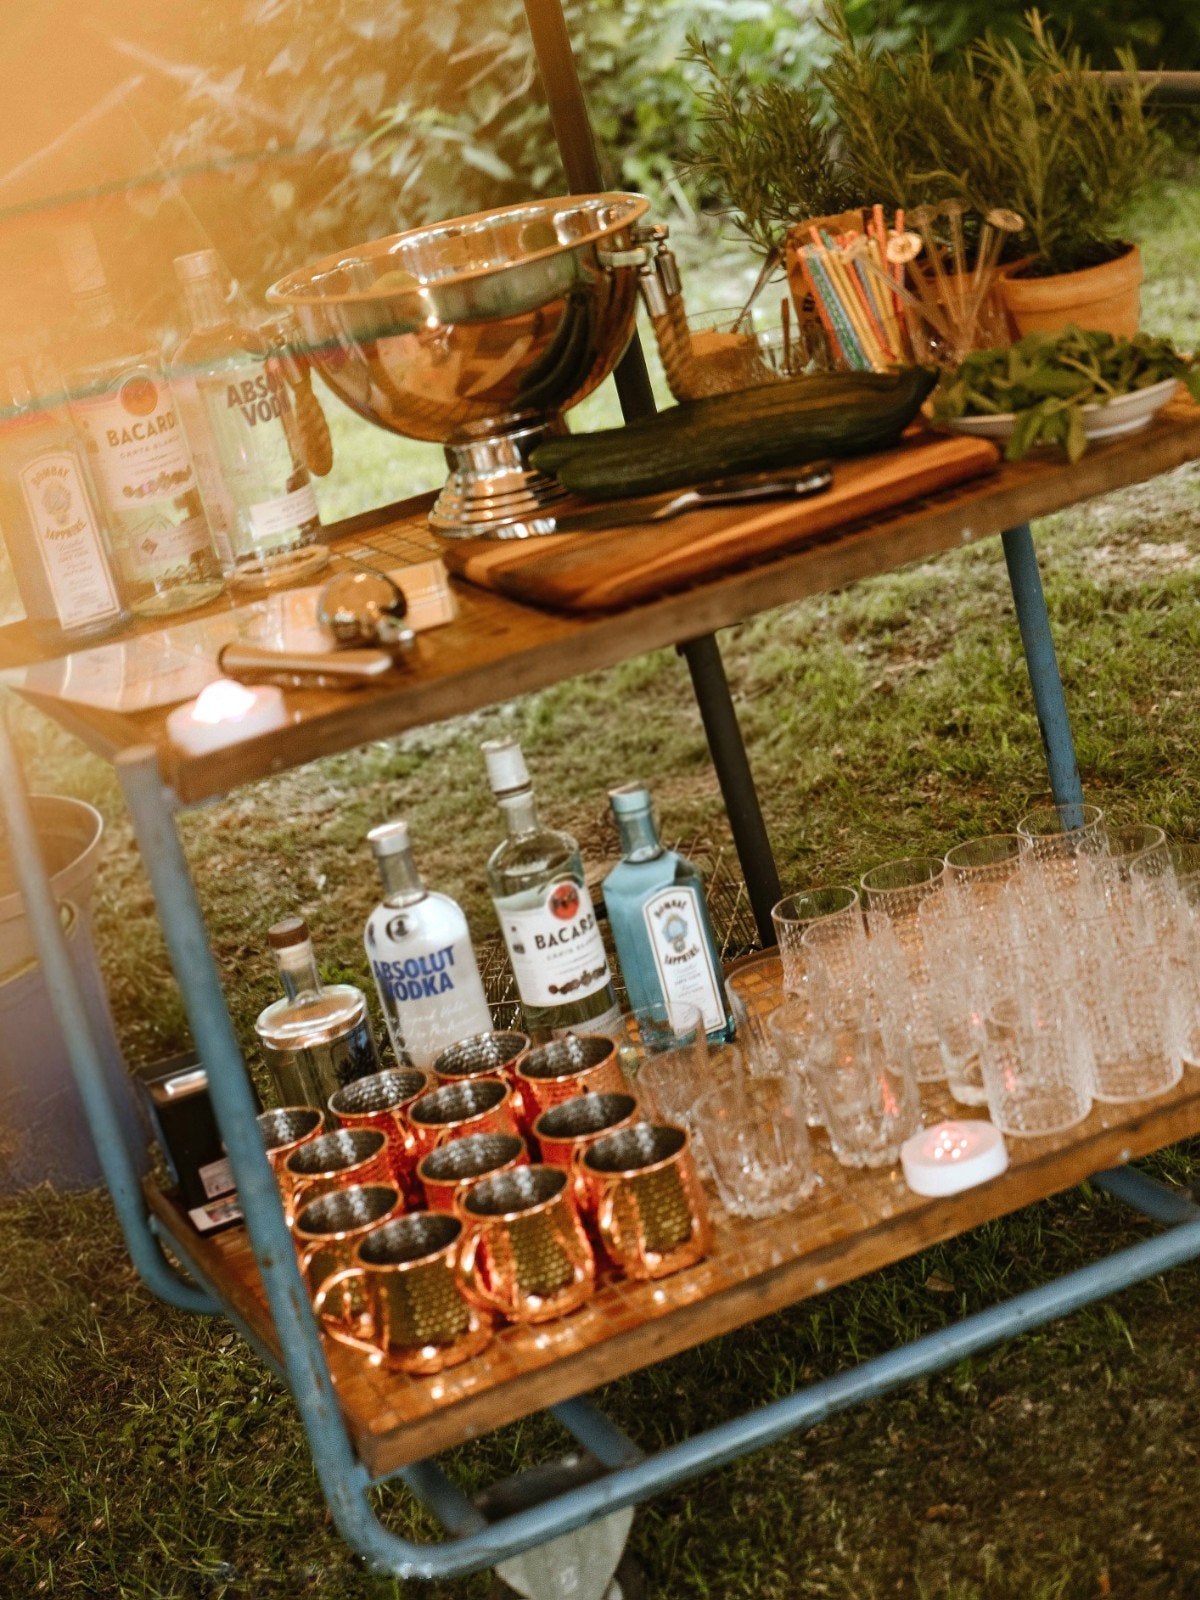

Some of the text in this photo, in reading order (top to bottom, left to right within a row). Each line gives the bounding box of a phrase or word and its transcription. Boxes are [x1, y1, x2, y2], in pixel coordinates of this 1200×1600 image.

[105, 411, 179, 448] BACARD
[373, 944, 455, 981] ABSOLUT
[385, 971, 455, 1002] VODKA
